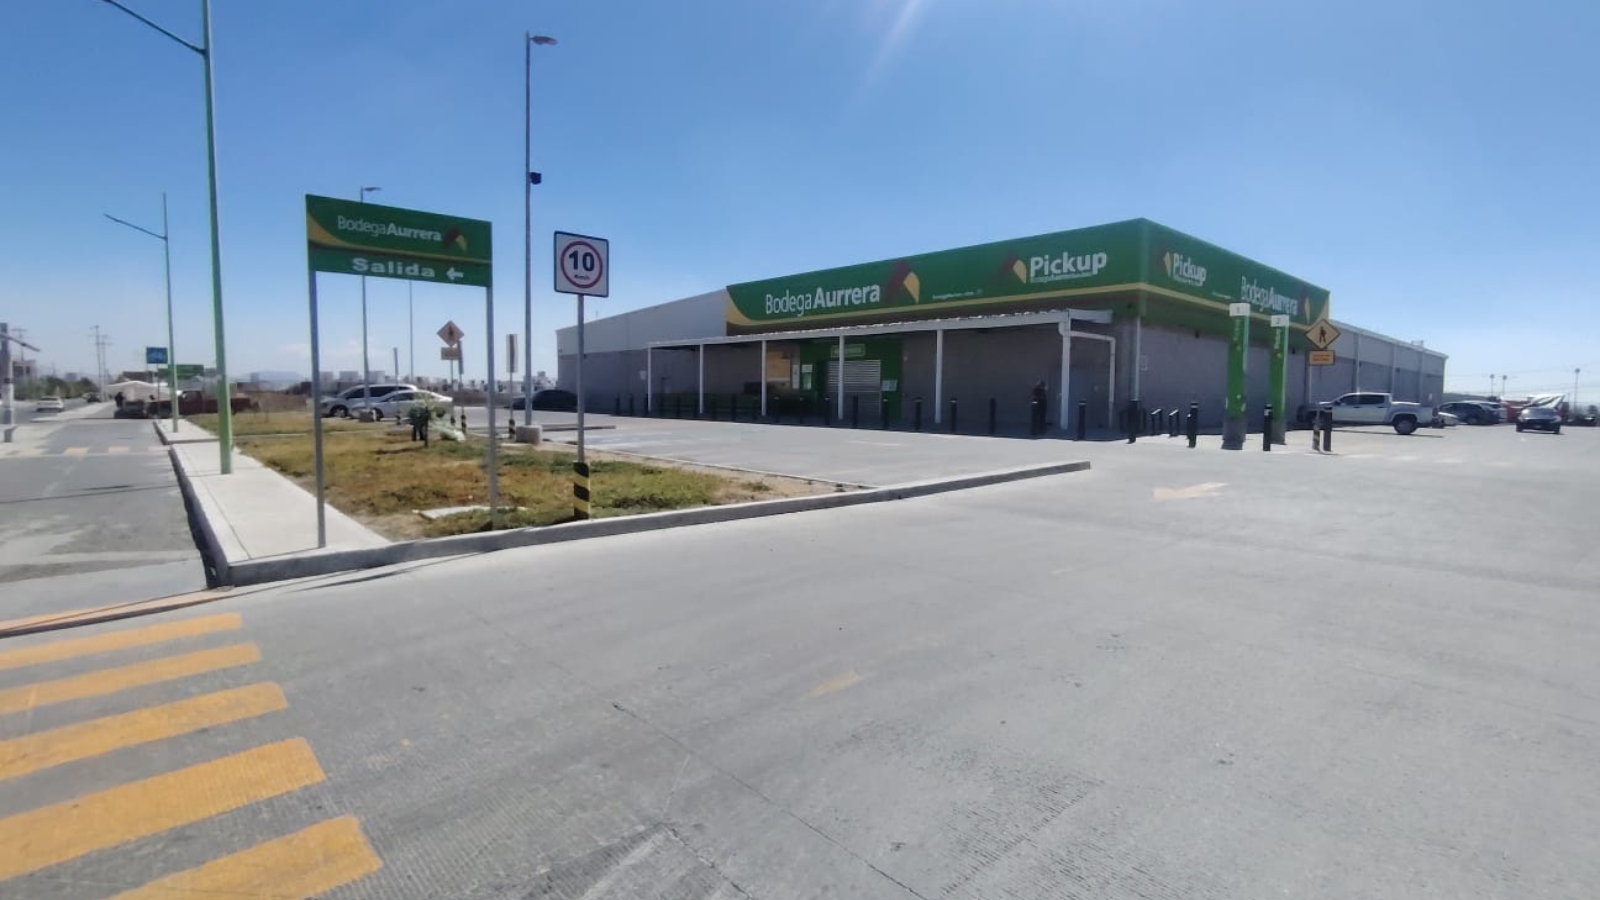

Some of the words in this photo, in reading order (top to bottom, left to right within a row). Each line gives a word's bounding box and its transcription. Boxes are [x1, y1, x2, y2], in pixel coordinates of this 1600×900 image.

[352, 258, 435, 278] Salida
[569, 250, 595, 272] 10
[1030, 251, 1107, 277] Pickup
[1173, 252, 1207, 284] Pickup
